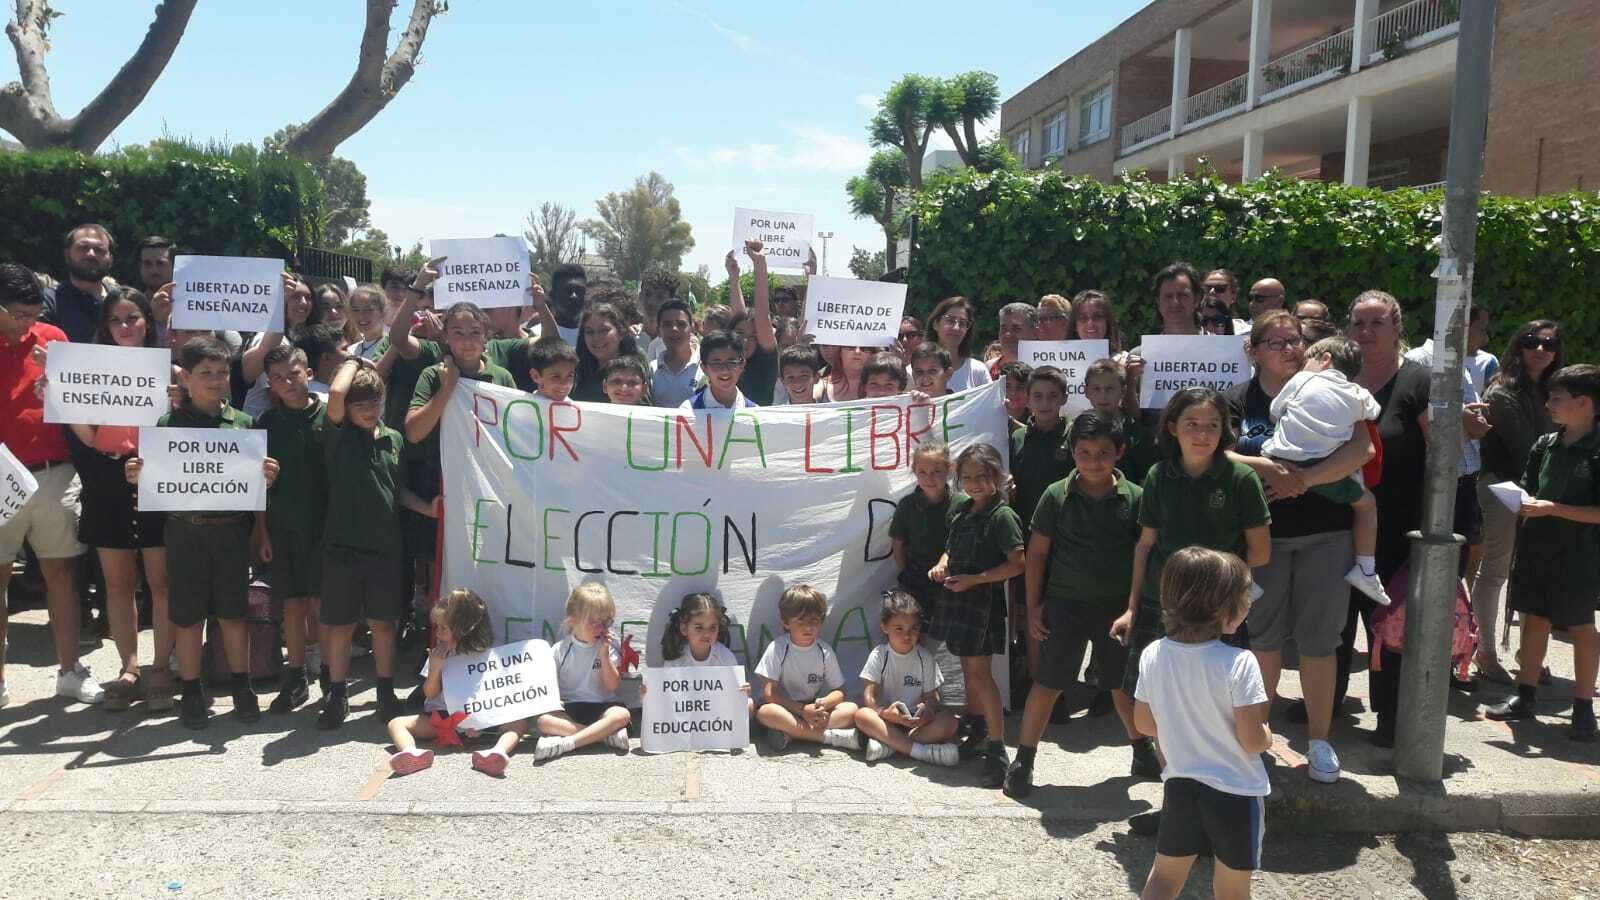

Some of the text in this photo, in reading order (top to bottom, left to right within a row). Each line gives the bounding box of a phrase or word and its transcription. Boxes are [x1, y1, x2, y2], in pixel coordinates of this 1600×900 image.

[750, 218, 796, 231] POR UNA
[445, 261, 521, 275] LIBERTAD DE
[185, 281, 271, 296] LIBERTAD DE
[447, 278, 521, 292] ENSEÑANZA
[187, 298, 269, 314] ENSEÑANZA
[817, 301, 892, 317] LIBERTAD DE
[817, 318, 887, 331] ENSEÑANZA
[1033, 351, 1086, 362] POR UNA
[1153, 361, 1239, 374] LIBERTAD DE
[60, 371, 157, 388] LIBERTAD DE
[62, 390, 154, 407] ENSEÑANZA
[472, 392, 582, 463] POR
[625, 411, 767, 473] UNA
[168, 440, 240, 454] POR UNA
[183, 462, 225, 474] LIBRE
[6, 473, 27, 500] POR
[157, 479, 248, 494] EDUCACIÓN
[472, 498, 757, 578] ELECCIÓN
[467, 651, 533, 676] POR UNA
[484, 672, 523, 691] LIBRE
[662, 679, 723, 693] POR UNA
[463, 685, 548, 715] EDUCACIÓN
[675, 699, 711, 713] LIBRE
[652, 716, 733, 734] EDUCACIÓN
